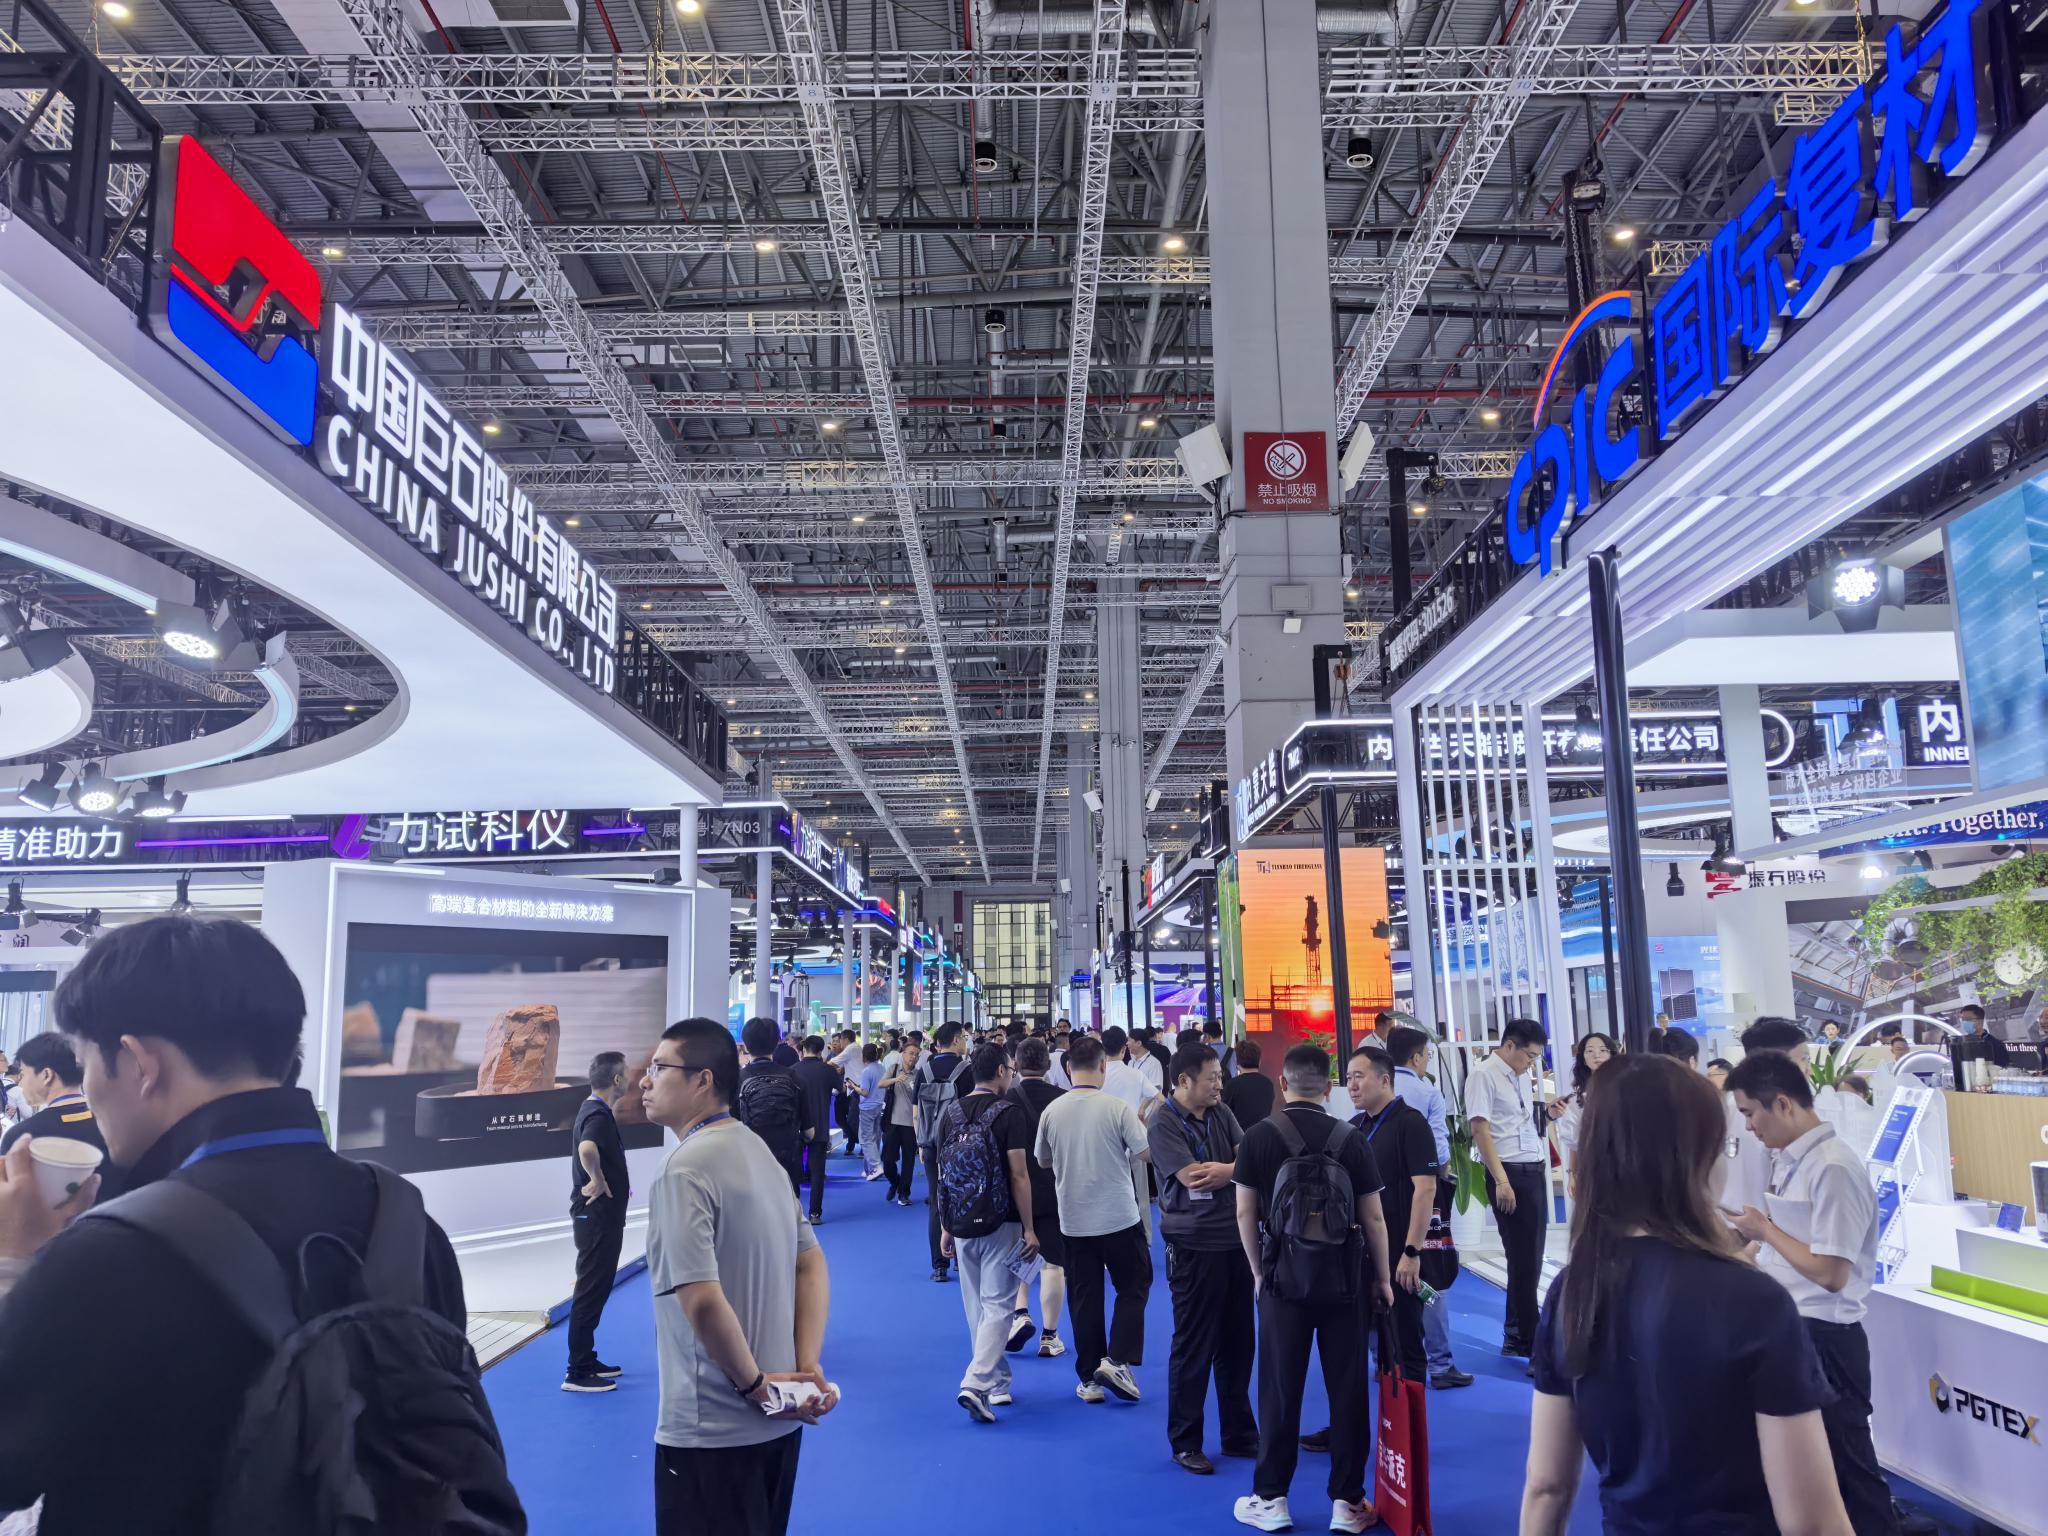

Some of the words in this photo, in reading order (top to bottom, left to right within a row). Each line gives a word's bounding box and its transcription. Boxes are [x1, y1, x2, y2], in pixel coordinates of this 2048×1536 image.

[1654, 0, 1984, 440] 国际复材
[332, 302, 616, 650] 中国巨石股份有限公司
[1257, 482, 1317, 497] 禁止吸烟
[328, 414, 438, 554] CHINA
[454, 524, 526, 624] JUSHI
[583, 635, 615, 694] LTD
[389, 809, 570, 853] 力试科仪
[1749, 869, 1826, 888] 振石股份
[1953, 1386, 2041, 1447] PGTEX
